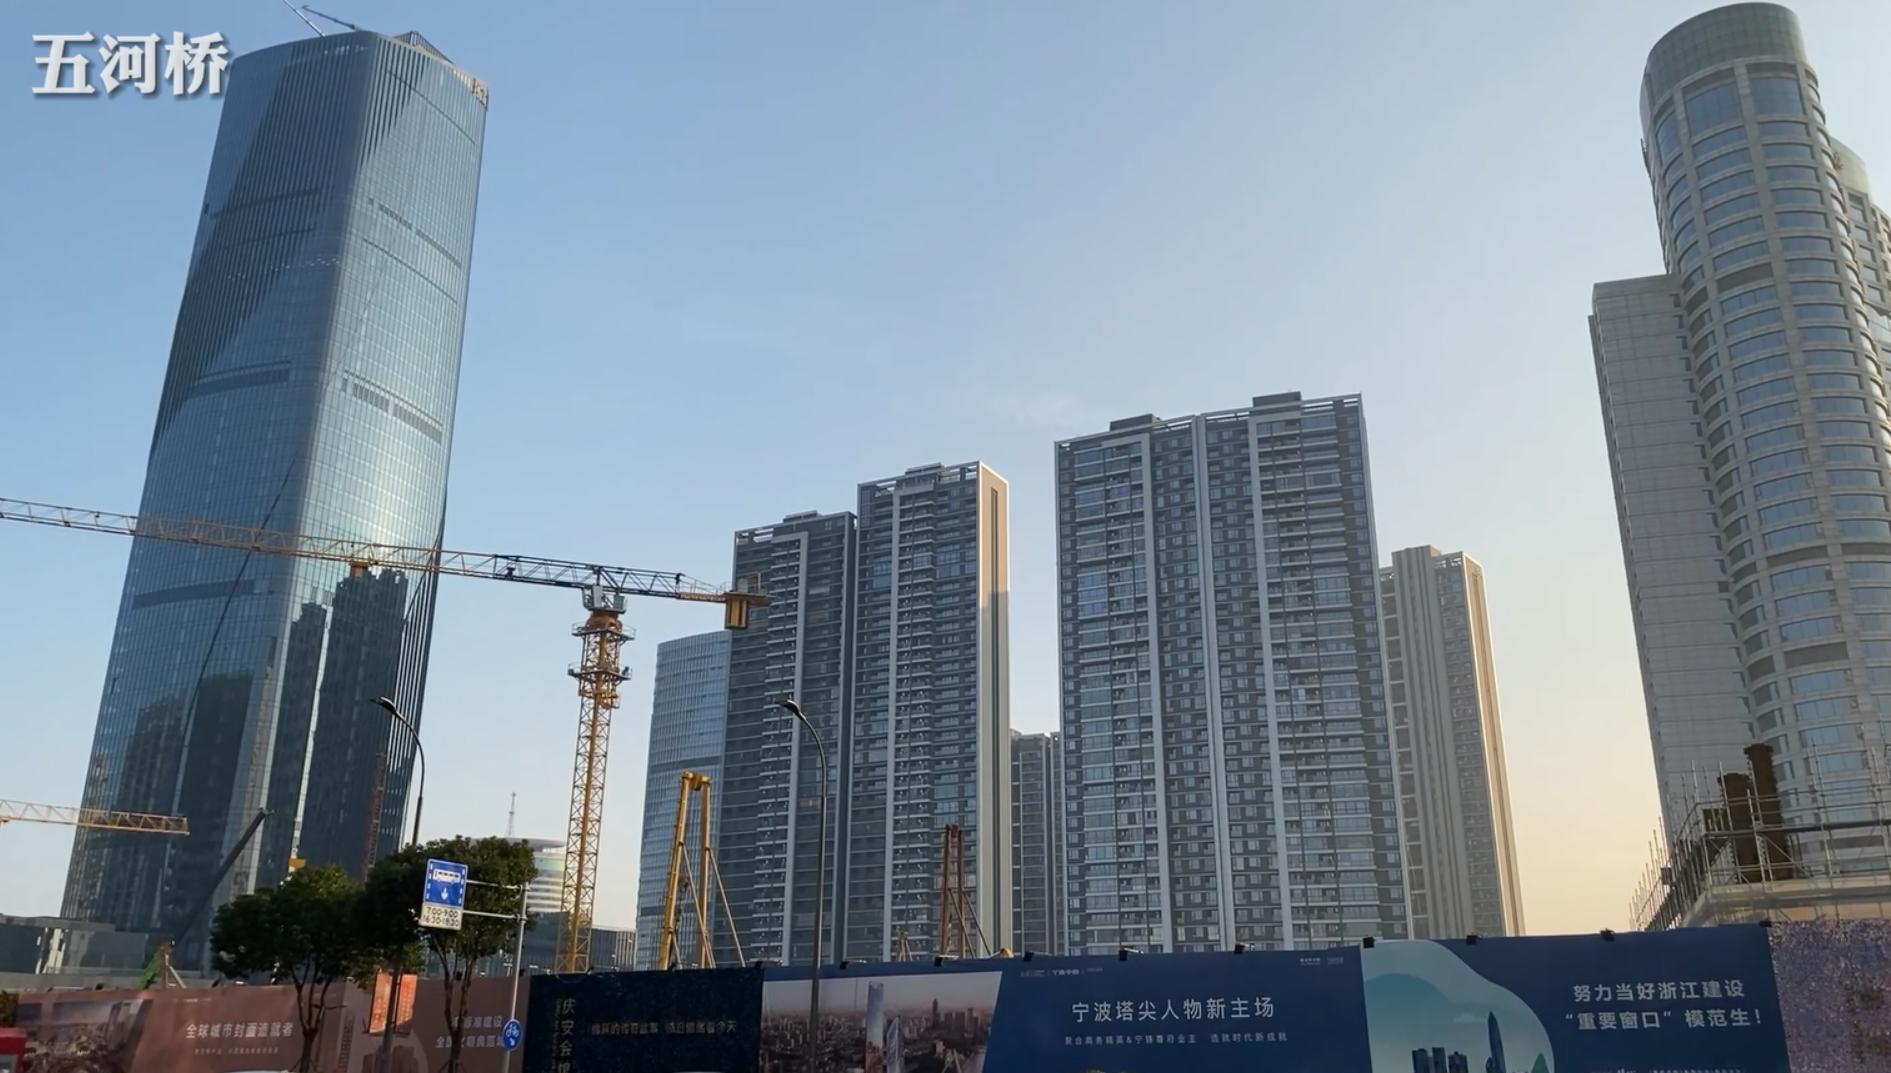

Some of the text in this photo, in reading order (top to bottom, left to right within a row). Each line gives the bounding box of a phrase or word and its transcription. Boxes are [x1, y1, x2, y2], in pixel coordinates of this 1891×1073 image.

[1573, 979, 1745, 1002] 努力当好浙江建设
[1071, 997, 1275, 1023] 宁波塔尖人物新主场
